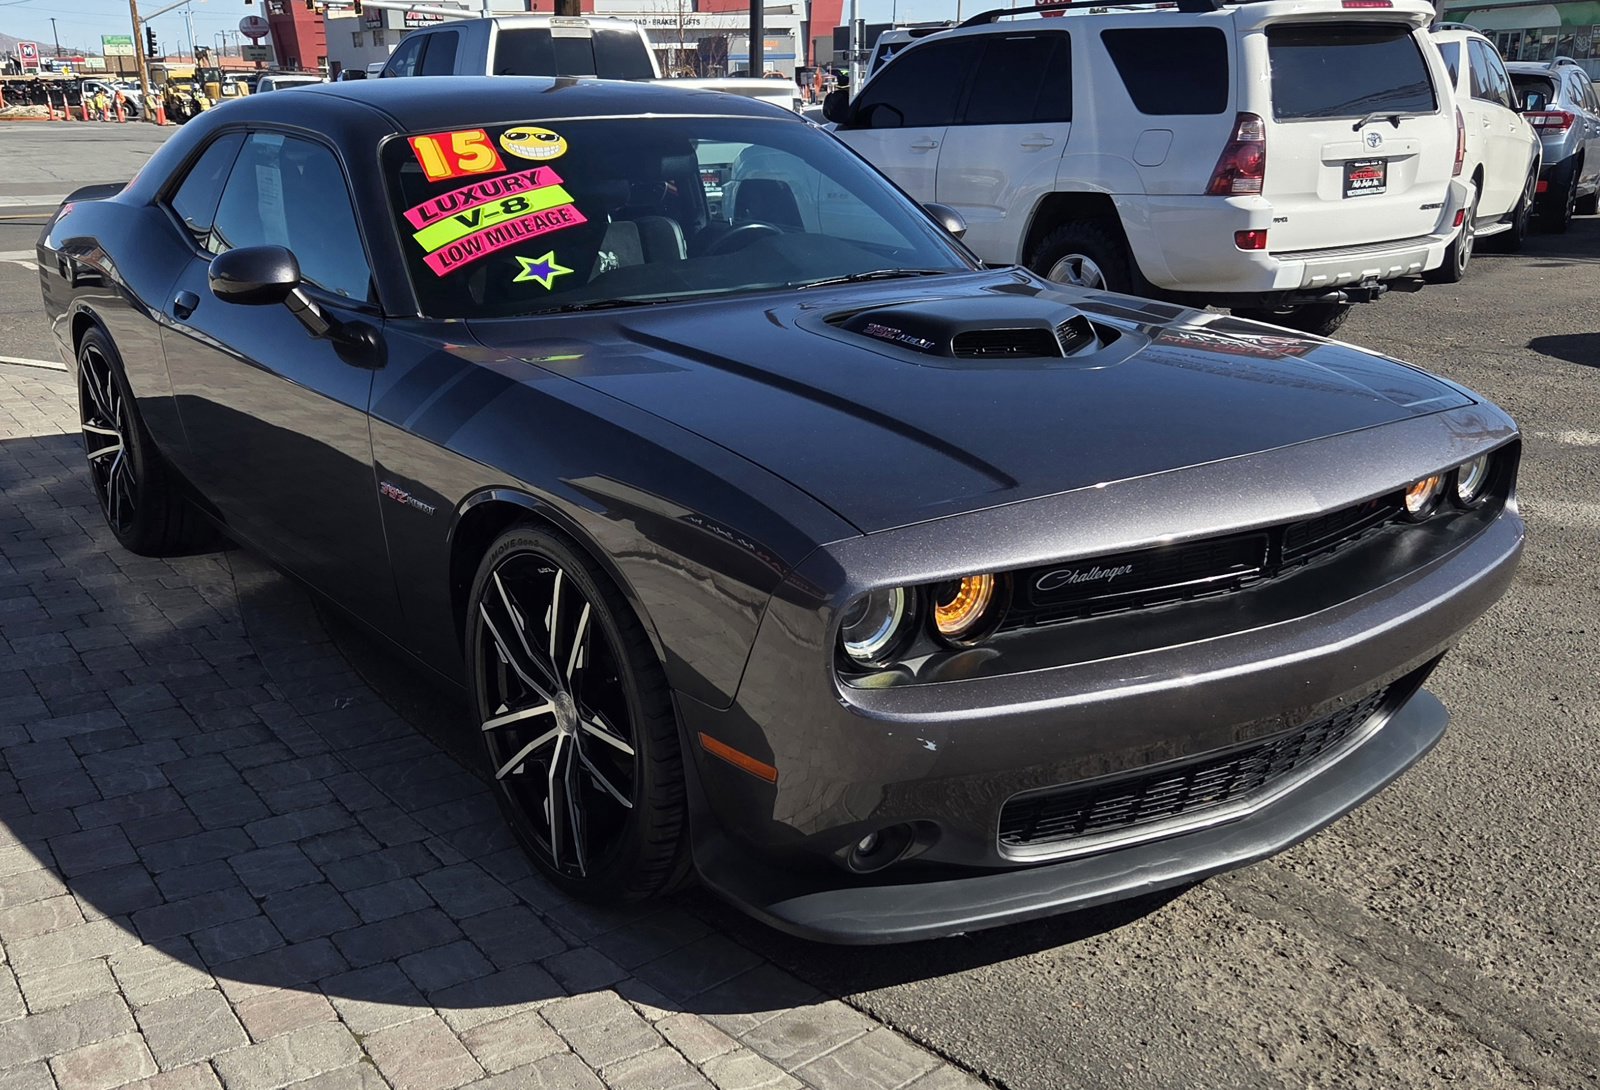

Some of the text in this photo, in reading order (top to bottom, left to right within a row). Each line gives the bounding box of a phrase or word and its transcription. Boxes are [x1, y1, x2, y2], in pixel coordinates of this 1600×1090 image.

[414, 131, 496, 178] 15
[417, 169, 543, 223] LUXURY
[454, 195, 531, 229] V-8
[437, 207, 573, 269] LOW MILEAGE
[1035, 563, 1133, 592] Challenger
